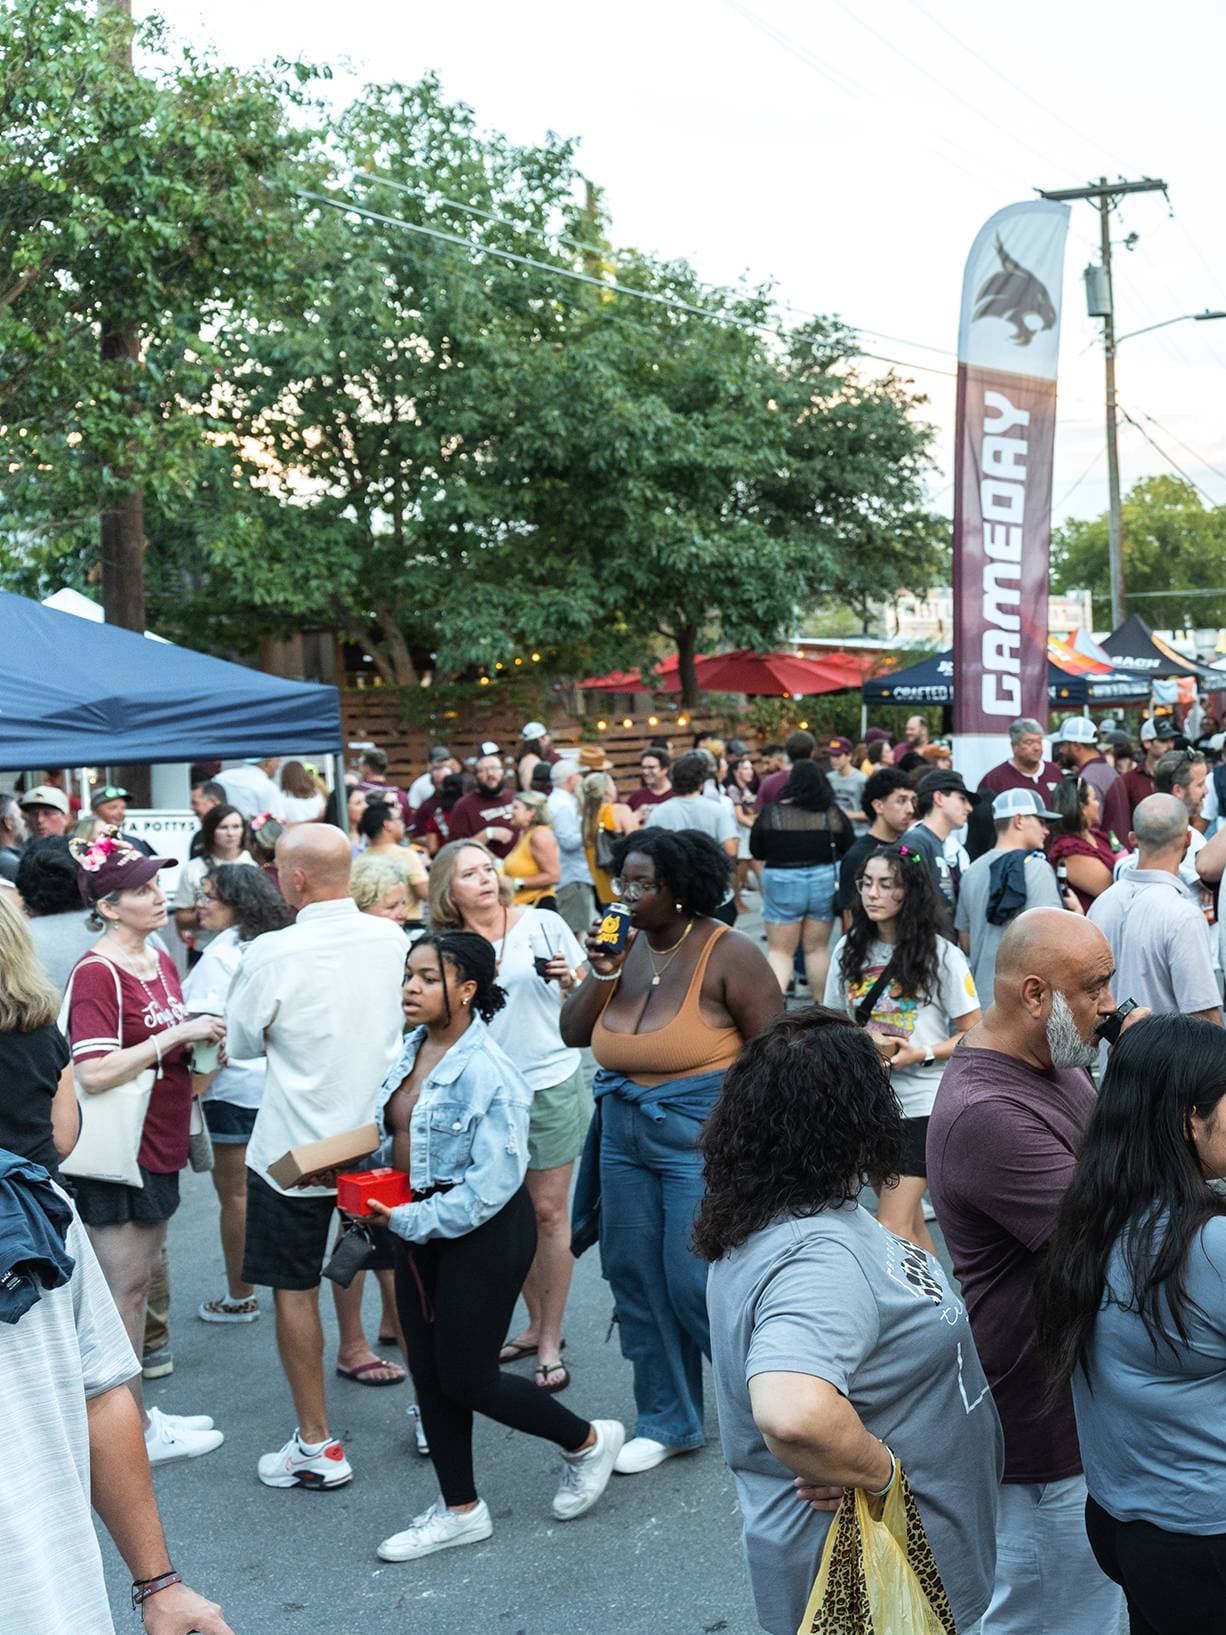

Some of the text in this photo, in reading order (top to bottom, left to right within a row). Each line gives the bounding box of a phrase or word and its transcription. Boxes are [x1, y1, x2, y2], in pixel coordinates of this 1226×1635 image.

[980, 389, 1031, 717] GAMEDAY
[893, 686, 948, 700] CRAFTED
[144, 822, 195, 833] POTTYS
